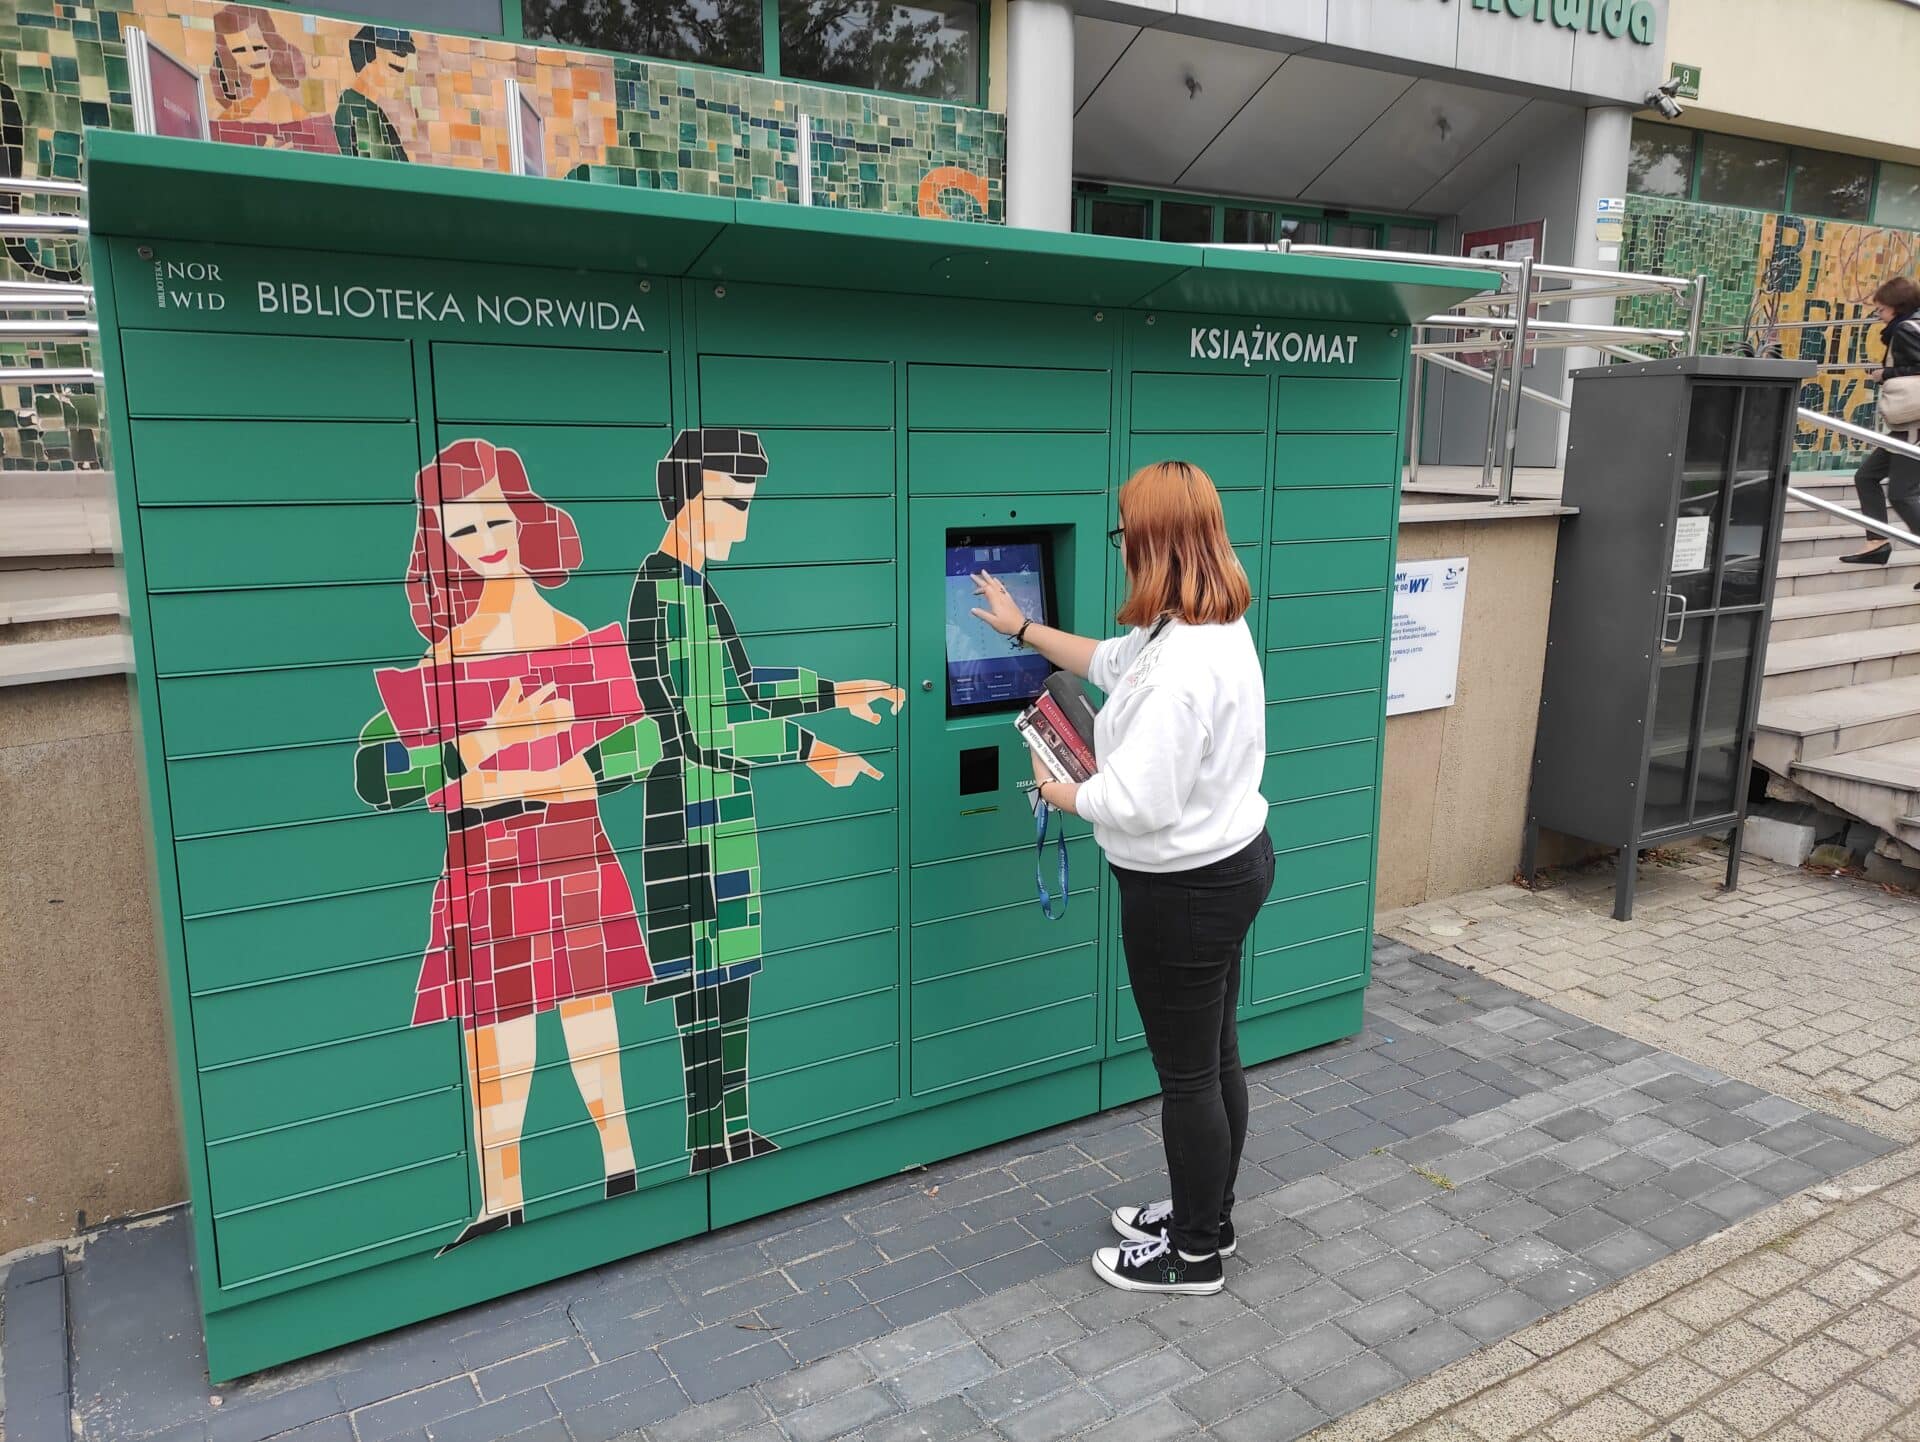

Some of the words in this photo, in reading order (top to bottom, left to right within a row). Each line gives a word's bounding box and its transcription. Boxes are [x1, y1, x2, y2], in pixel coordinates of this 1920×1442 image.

[1472, 0, 1657, 46] wida
[1682, 69, 1690, 84] 9
[154, 260, 166, 308] BIBLIOTEKA
[167, 261, 223, 281] NOR
[170, 290, 225, 311] WID
[258, 281, 465, 322] BIBLIOTEKA
[477, 294, 645, 332] NORWIDA
[1190, 323, 1358, 367] KSIĄŻKOMAT
[1409, 577, 1429, 593] WY
[1027, 729, 1043, 749] Getting
[1042, 745, 1056, 766] Things
